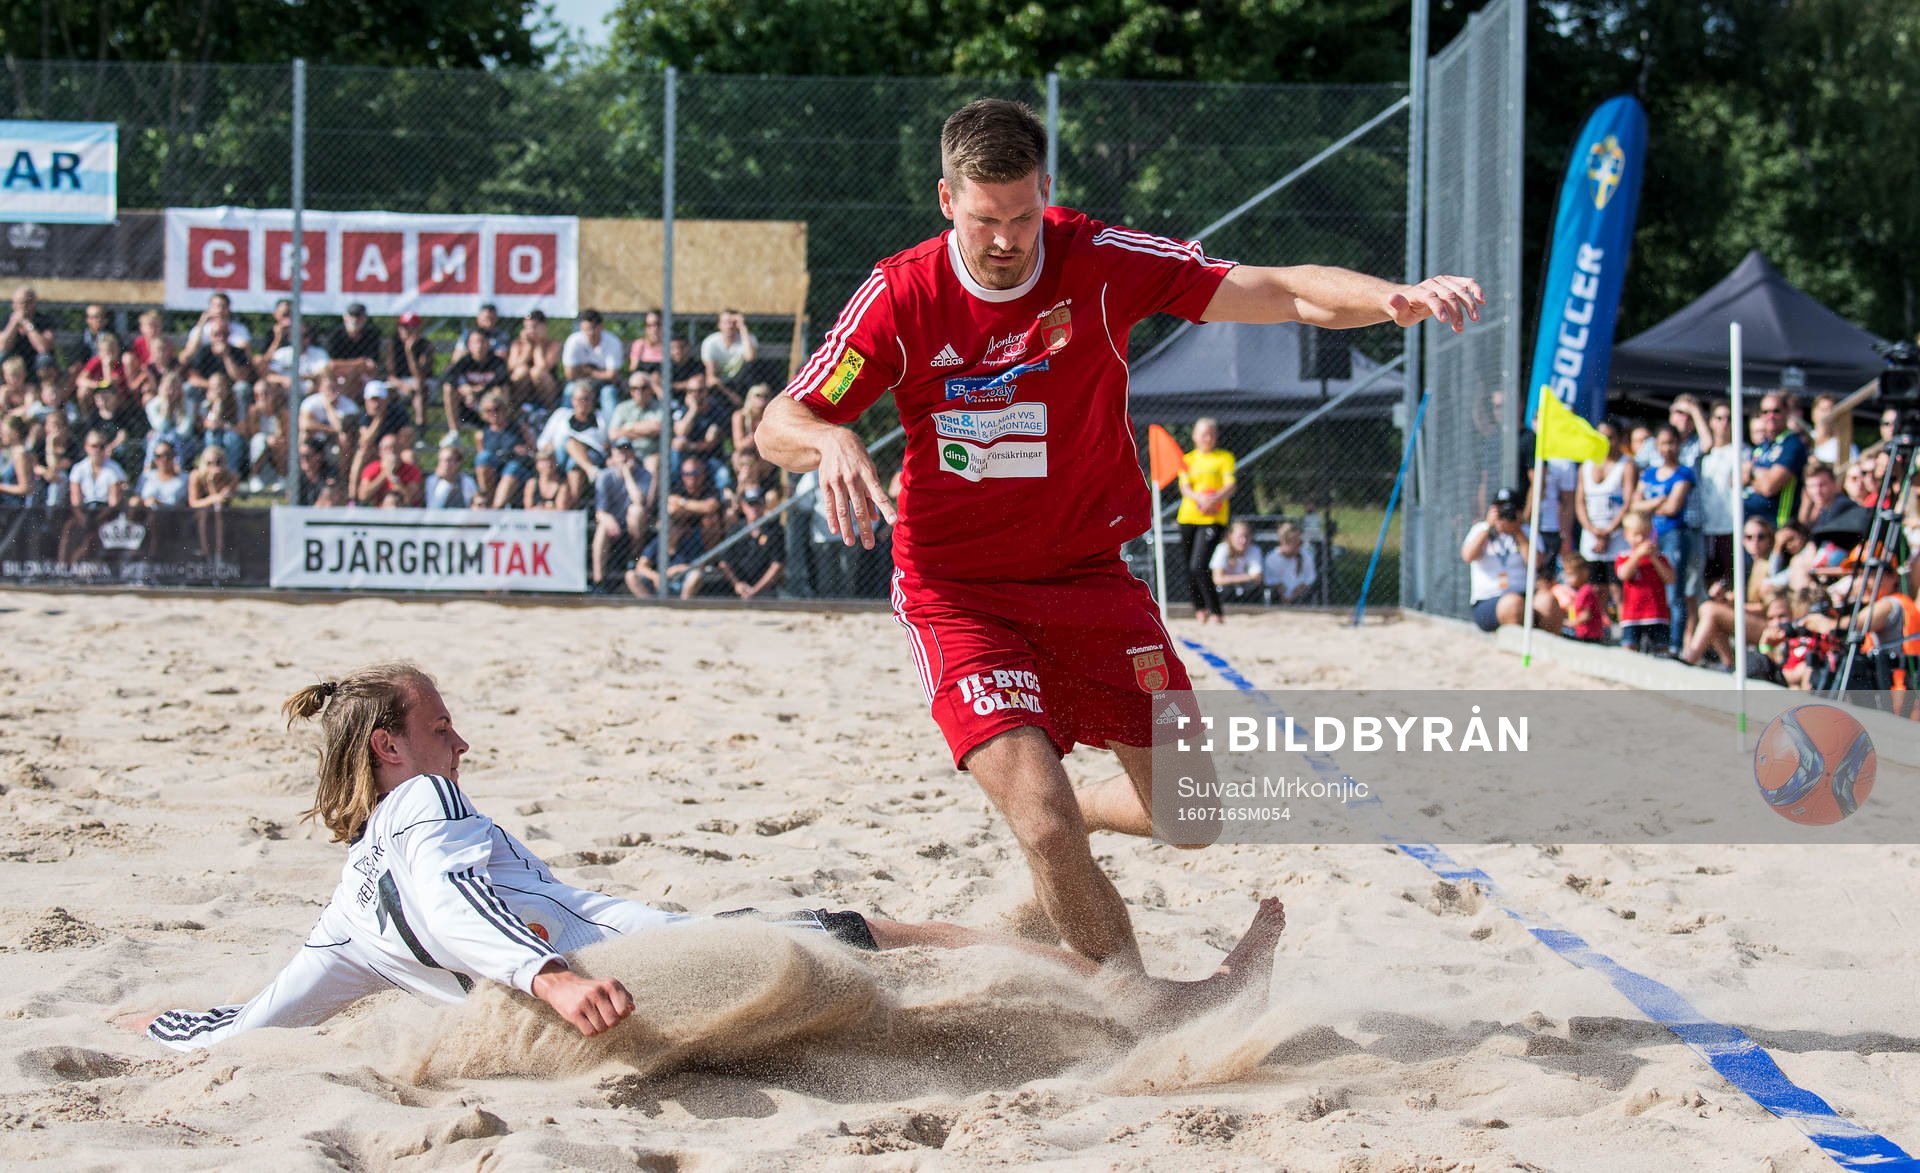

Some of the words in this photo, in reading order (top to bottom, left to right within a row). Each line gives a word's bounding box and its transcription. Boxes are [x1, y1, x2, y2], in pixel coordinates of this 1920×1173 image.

[3, 151, 82, 189] AR
[202, 239, 543, 284] CRAMO
[1551, 242, 1604, 408] SOCCER
[930, 357, 964, 367] adidas
[939, 415, 960, 425] Bad
[961, 415, 974, 428] &
[980, 413, 1016, 429] KALMAR
[1018, 411, 1035, 420] VVS
[941, 422, 977, 436] Värme
[982, 430, 989, 439] &
[945, 450, 967, 462] dina
[305, 531, 552, 576] BJÄRGRIMTAK
[1137, 653, 1160, 668] GIF
[973, 690, 1044, 716] ÖLAND
